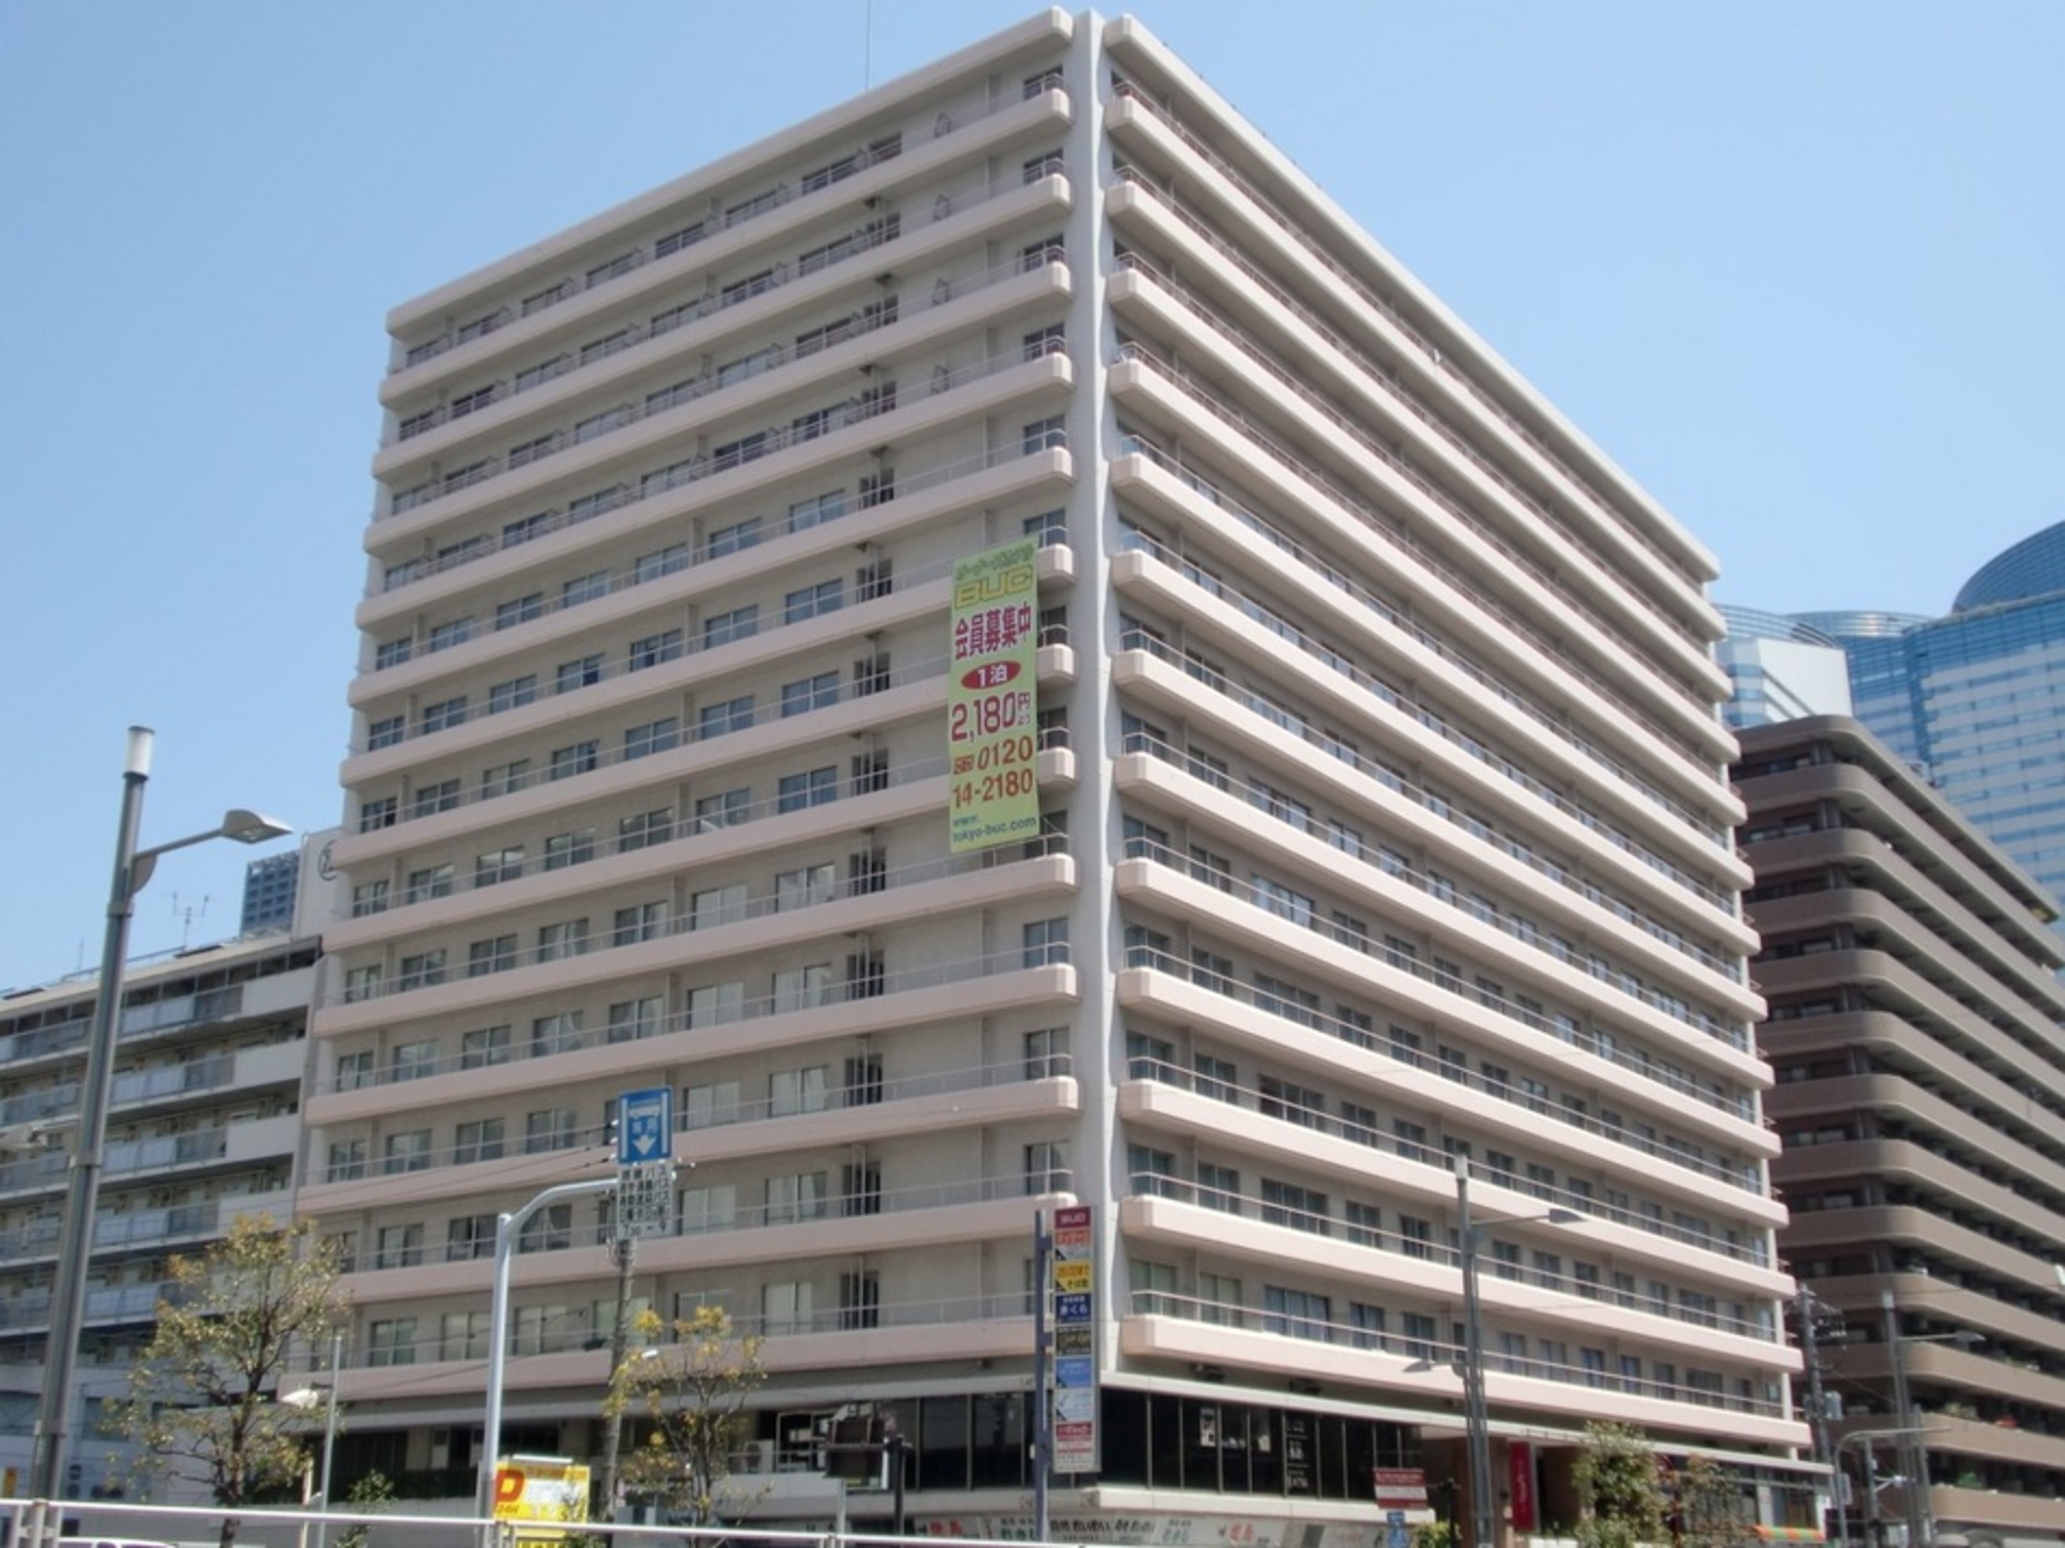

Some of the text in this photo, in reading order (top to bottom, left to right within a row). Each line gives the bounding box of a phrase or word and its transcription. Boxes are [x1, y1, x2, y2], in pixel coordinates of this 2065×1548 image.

[955, 565, 1034, 610] BUC
[956, 600, 1032, 660] 会員募集中
[977, 664, 1008, 687] 1泊
[977, 735, 1033, 770] 0120
[953, 768, 1033, 808] 14-2180
